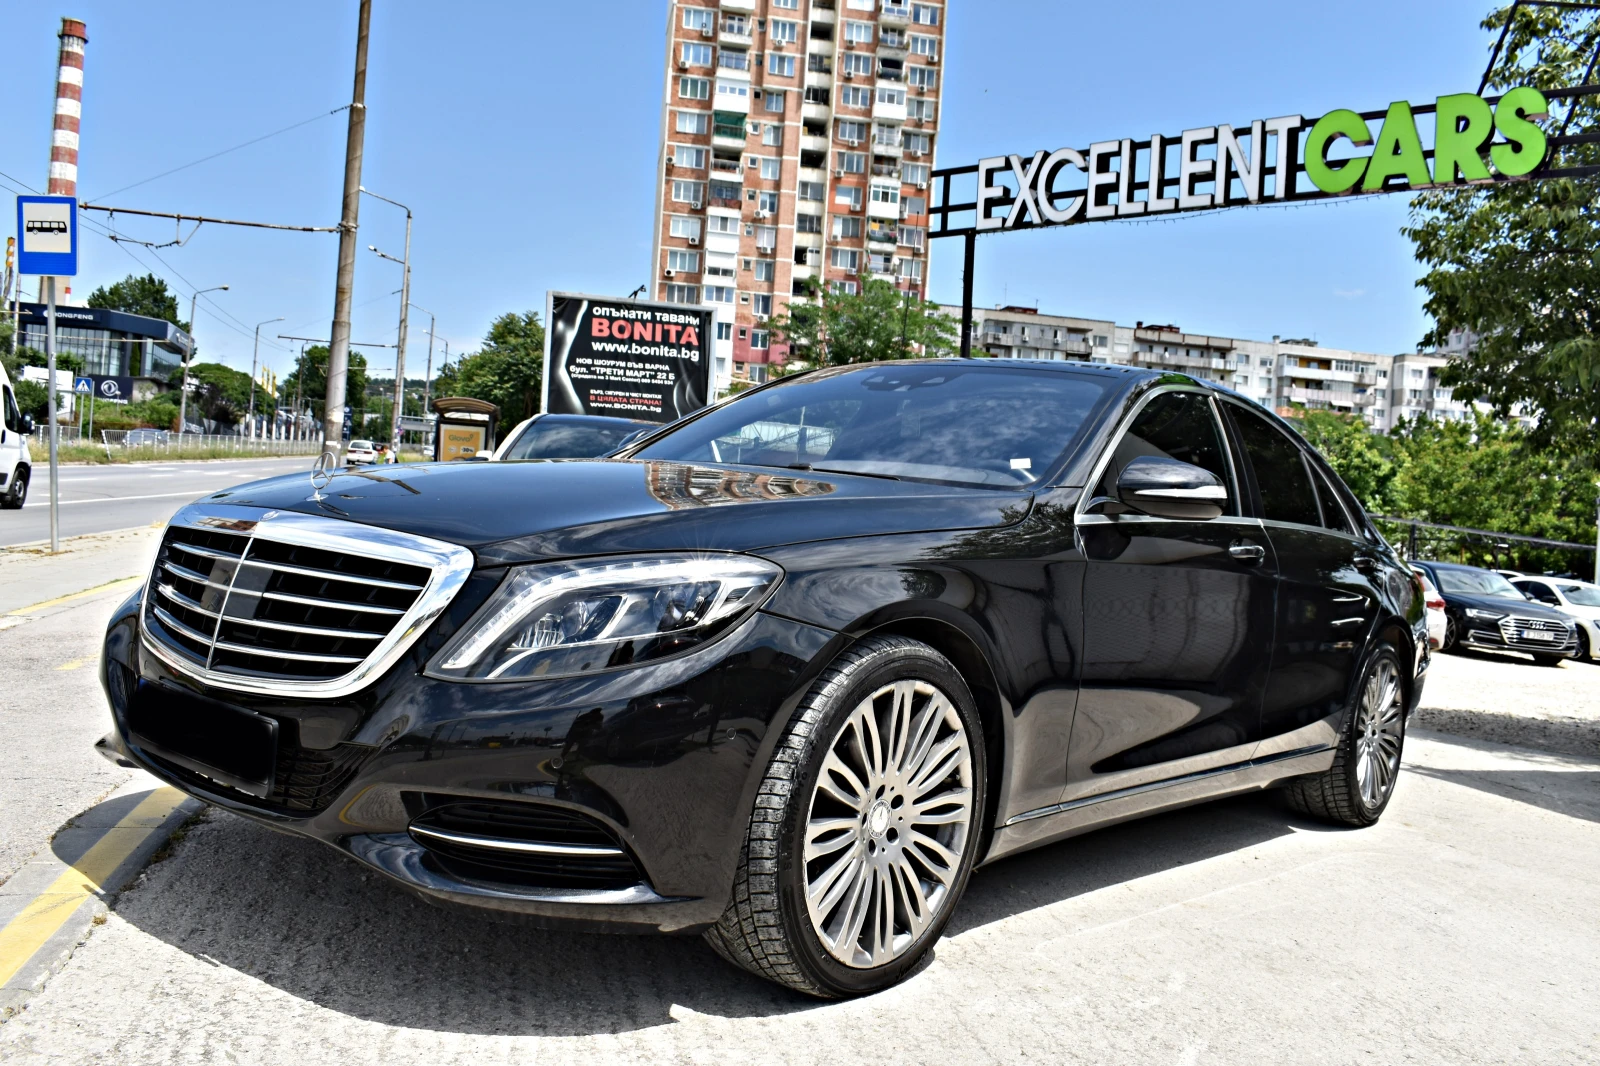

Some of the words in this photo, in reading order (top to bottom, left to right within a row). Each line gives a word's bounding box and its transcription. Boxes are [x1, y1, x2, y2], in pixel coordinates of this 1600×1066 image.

[976, 114, 1304, 230] EXCELLENT
[1304, 86, 1548, 194] CARS
[592, 306, 652, 320] опънати
[655, 312, 700, 325] тавани
[591, 318, 699, 346] BONITA
[591, 341, 700, 362] www.bonita.bg
[569, 365, 588, 376] бул.
[656, 371, 667, 380] 22
[668, 372, 676, 380] Б
[576, 357, 593, 365] НОВ
[594, 359, 626, 368] ШОУРУМ
[627, 361, 644, 369] ВЪВ
[645, 363, 670, 371] ВАРНА
[589, 402, 662, 412] www.BONITA.bg
[597, 396, 628, 404] ЦЯЛАТА
[629, 397, 662, 406] СТРАНА!
